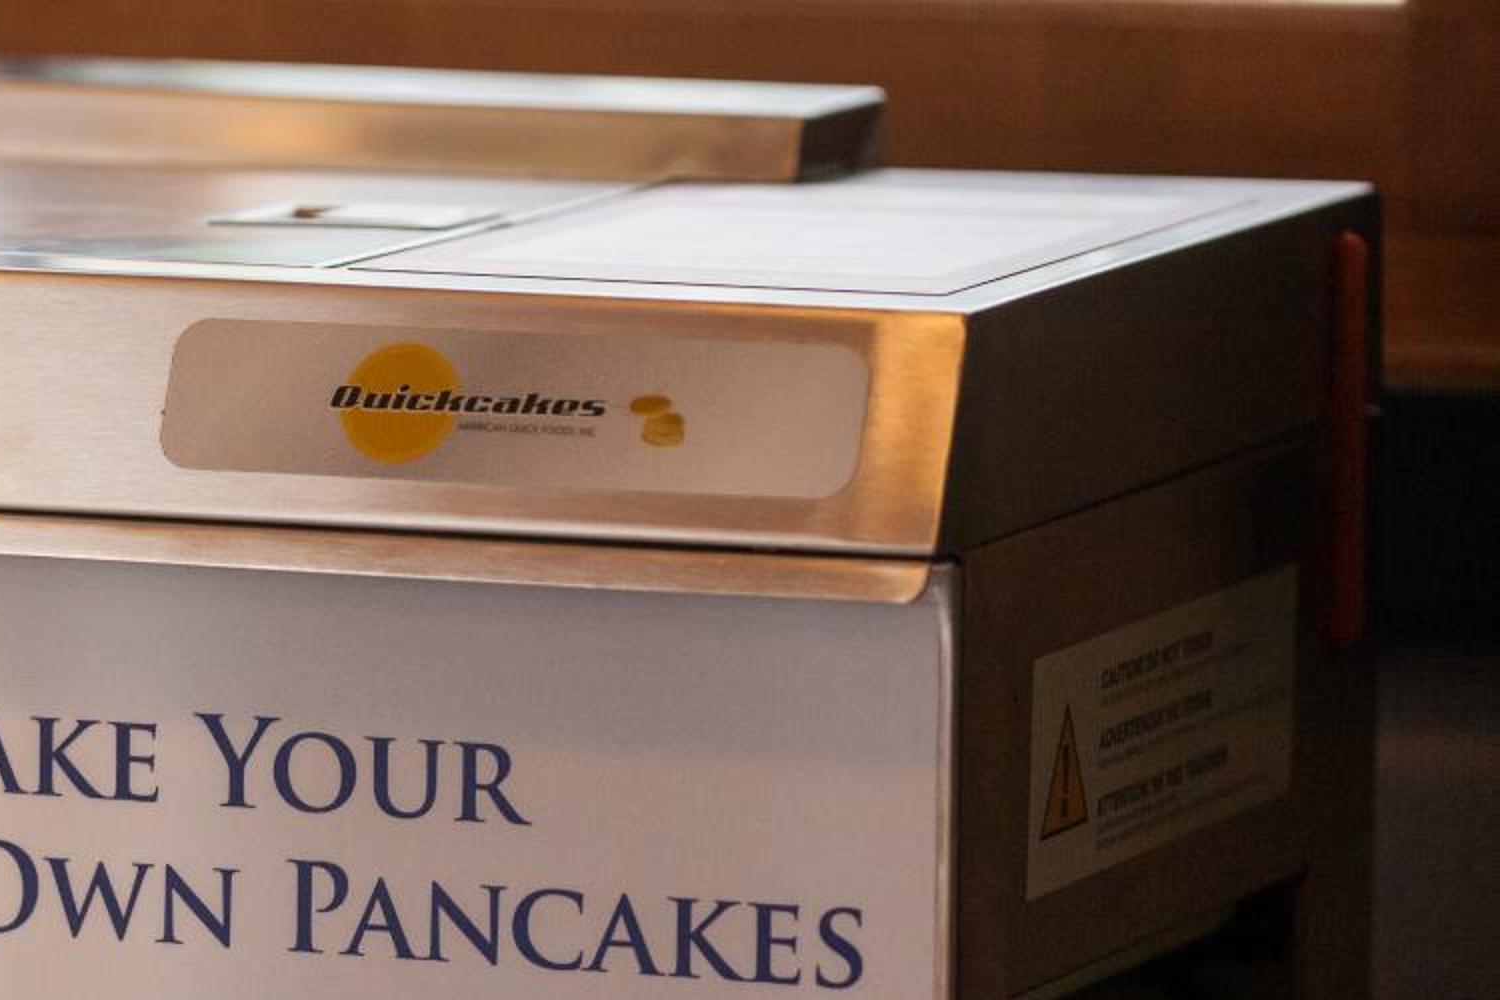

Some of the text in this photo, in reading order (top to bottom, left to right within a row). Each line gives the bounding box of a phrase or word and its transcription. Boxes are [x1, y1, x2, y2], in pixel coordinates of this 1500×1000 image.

[330, 384, 606, 417] Quickcakes
[193, 712, 533, 826] YOUR
[286, 859, 864, 989] PANCAKES
